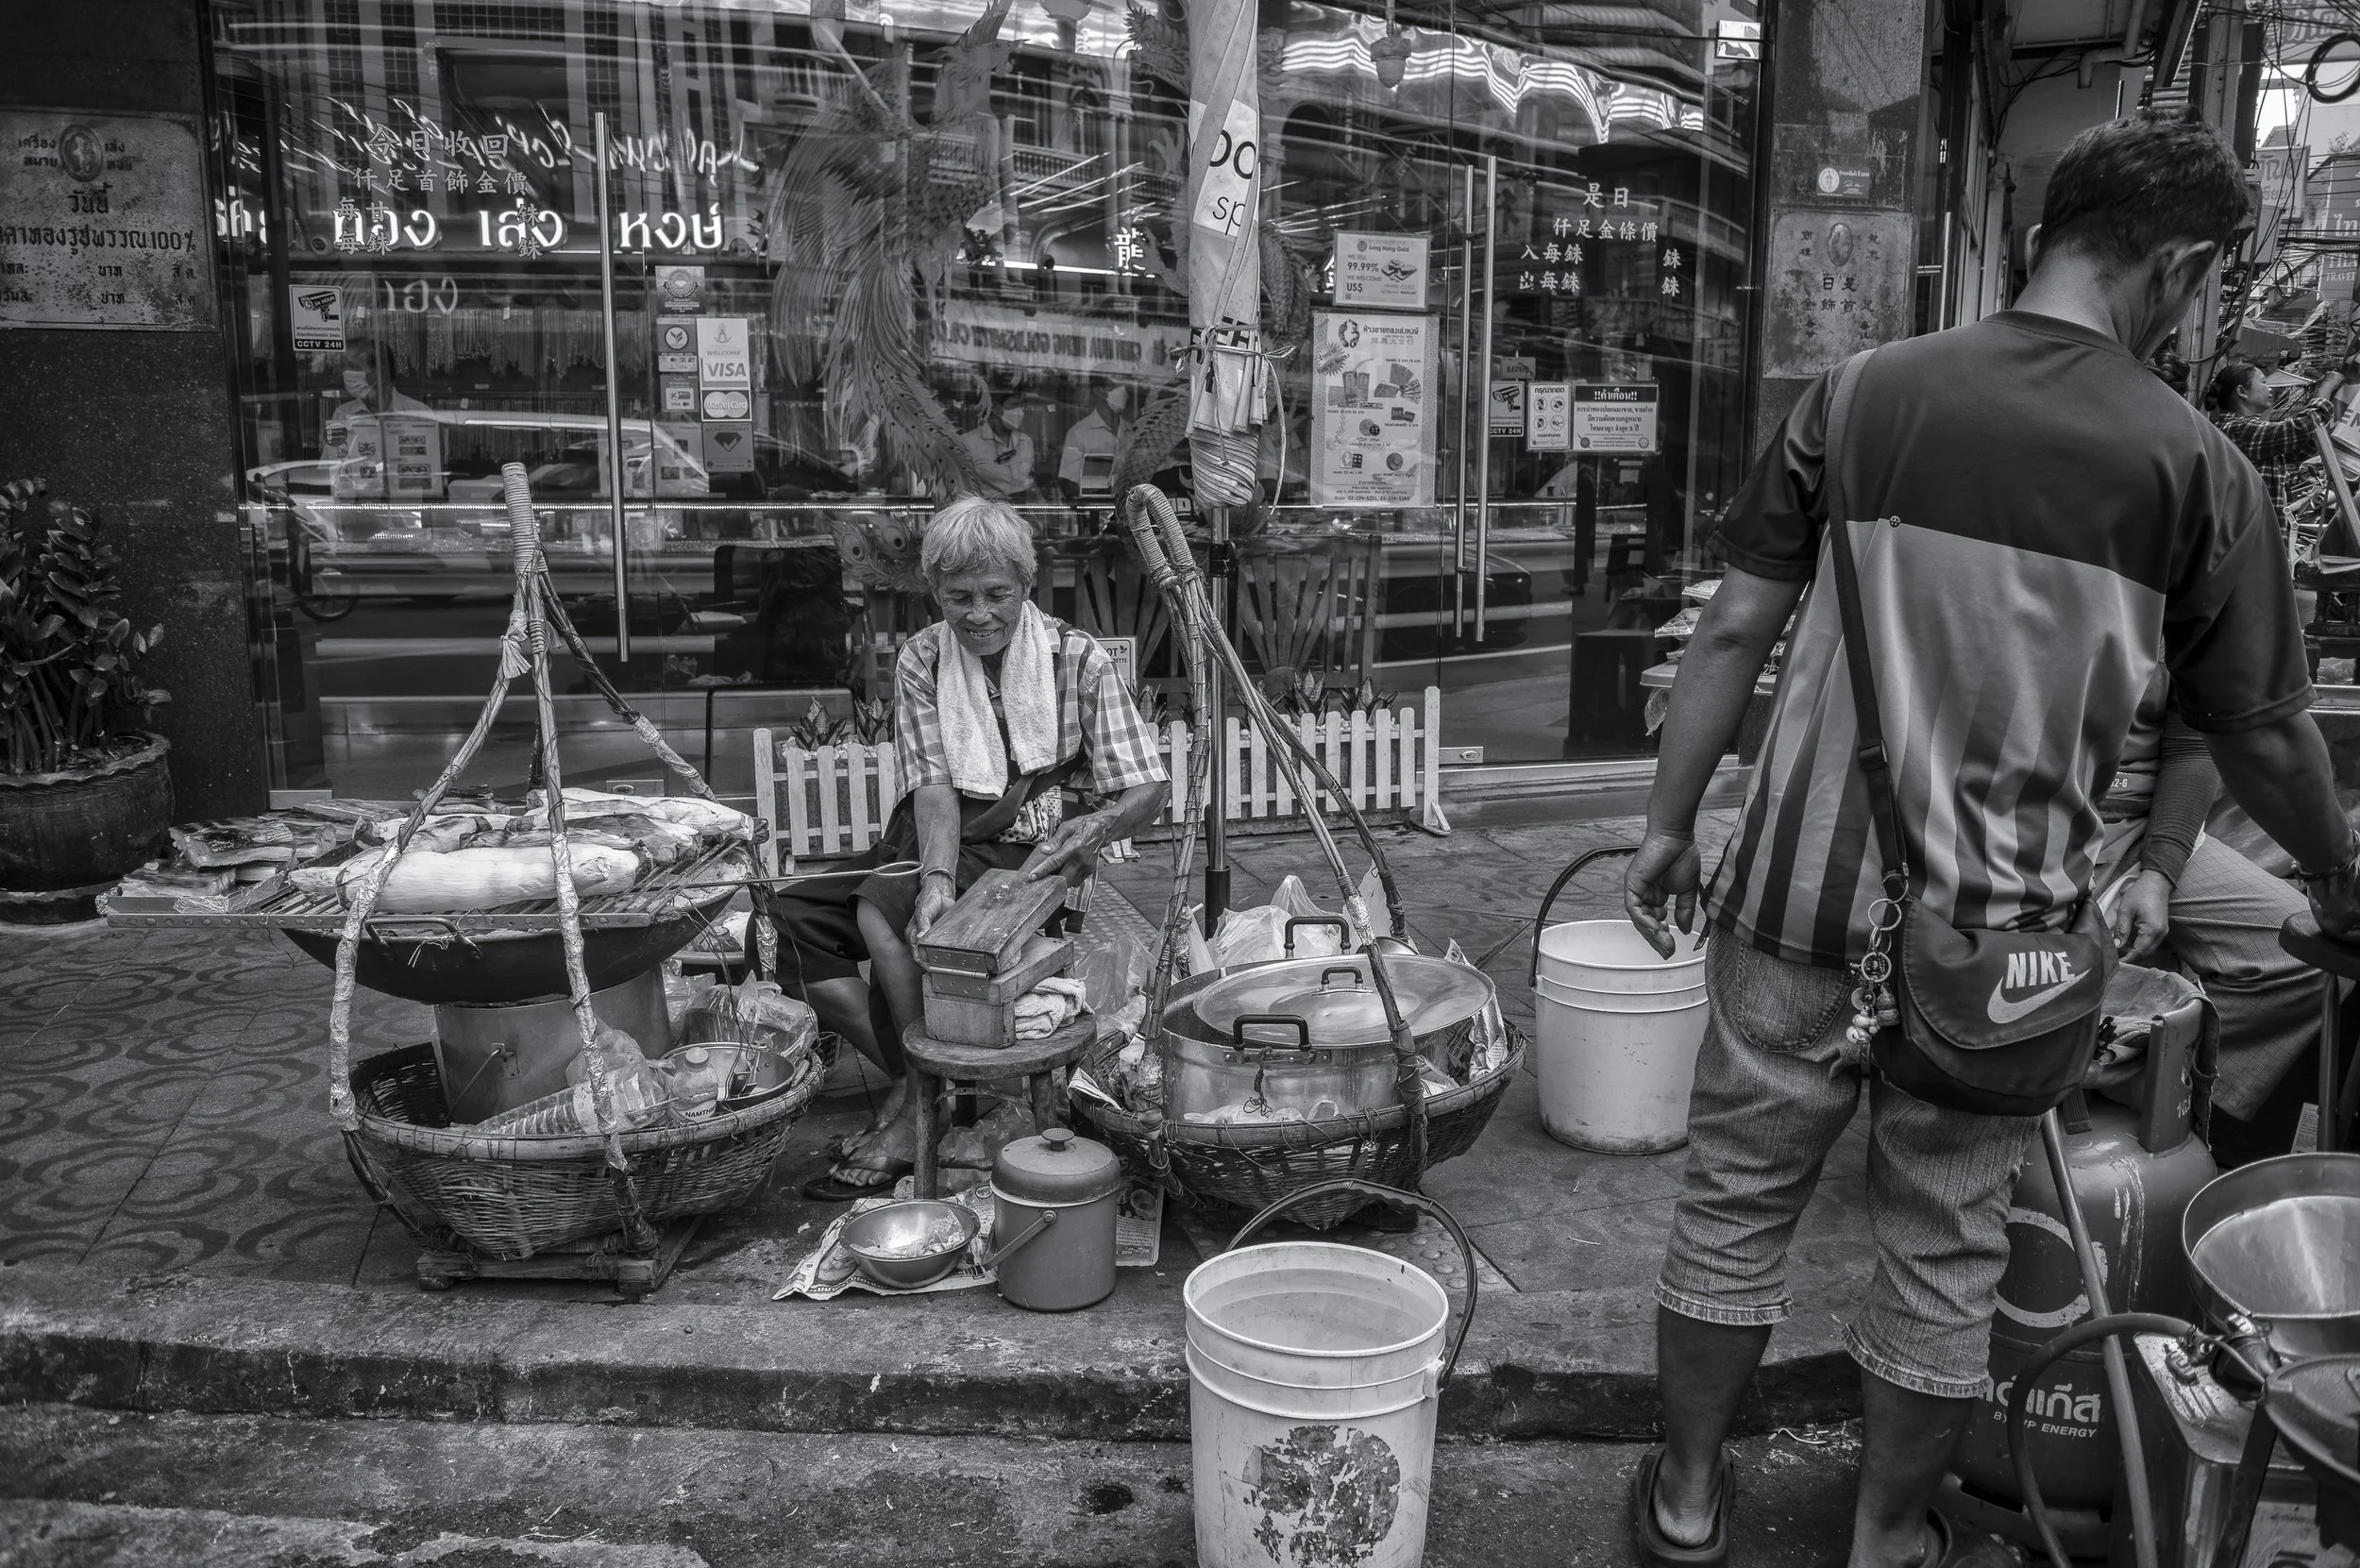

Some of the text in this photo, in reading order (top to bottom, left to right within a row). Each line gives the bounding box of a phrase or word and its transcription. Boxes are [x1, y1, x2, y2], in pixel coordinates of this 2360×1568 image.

[1582, 182, 1630, 209] 是日
[1347, 261, 1379, 273] 99.99%
[296, 340, 321, 348] CCTV
[706, 362, 747, 378] VISA
[2111, 778, 2128, 788] 2-6
[2006, 951, 2075, 989] NIKE
[2041, 1424, 2098, 1439] ENERGY
